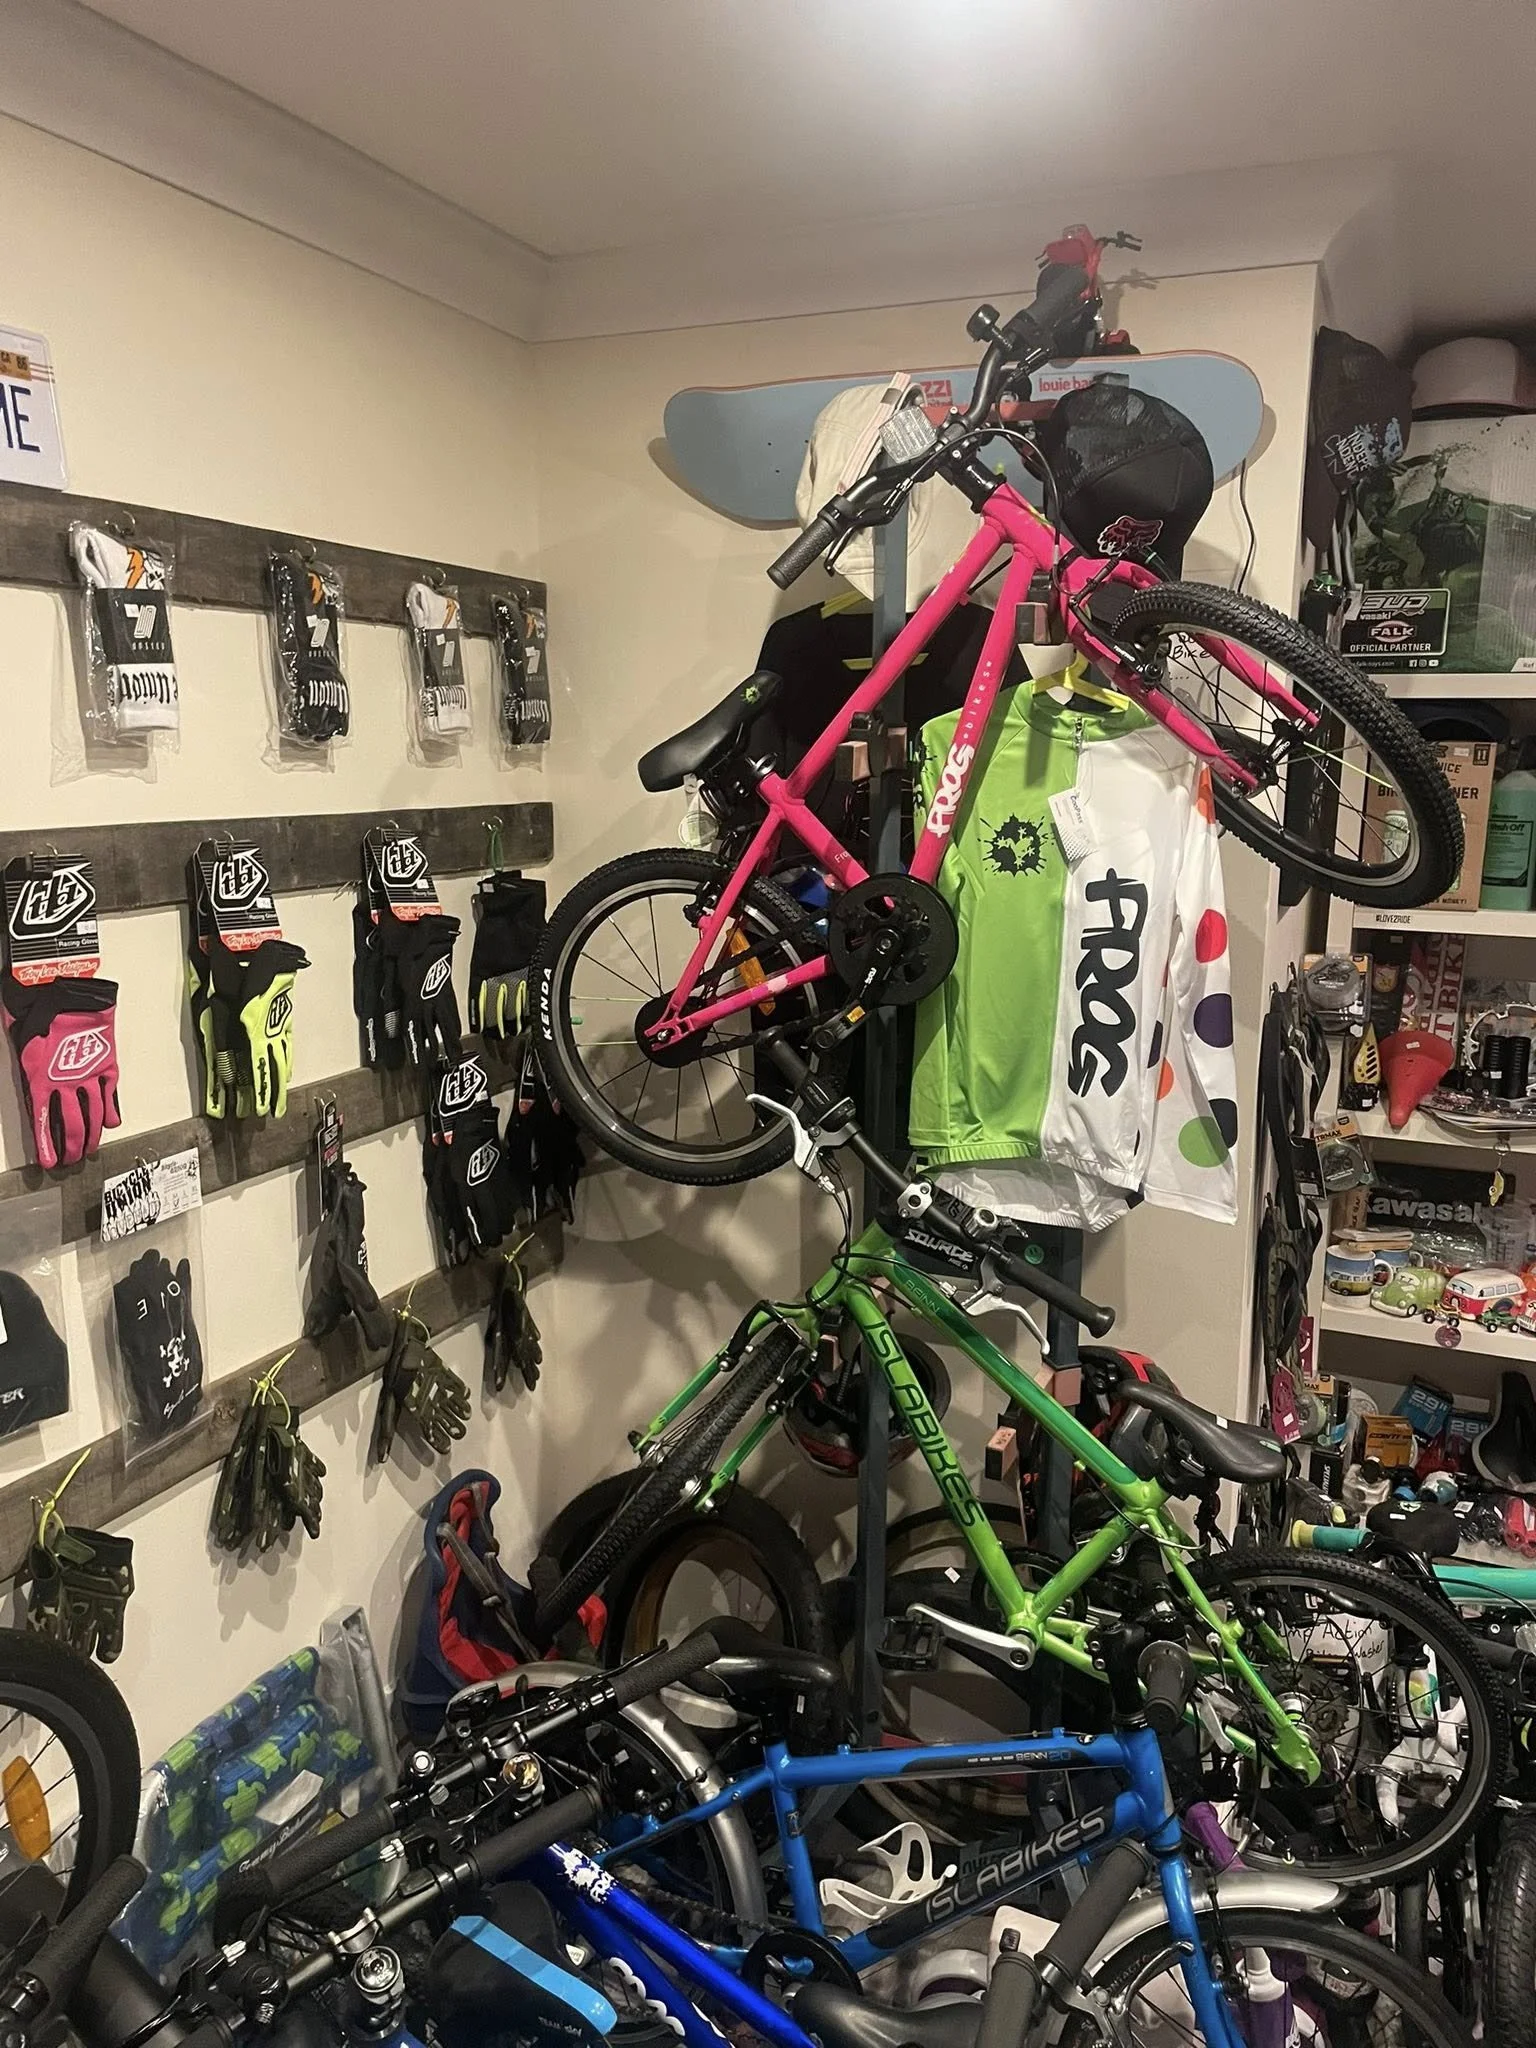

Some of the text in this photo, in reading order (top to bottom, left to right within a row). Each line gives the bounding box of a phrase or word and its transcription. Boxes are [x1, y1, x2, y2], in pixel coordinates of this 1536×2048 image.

[1039, 378, 1070, 392] louie
[1350, 642, 1432, 652] OFFICIAL PARTNER
[1370, 627, 1415, 637] FALK
[926, 742, 976, 839] FROG
[1067, 867, 1149, 1098] FROG
[540, 967, 554, 1041] KENDA
[904, 1228, 976, 1264] SOURCE
[904, 1278, 941, 1314] BEINN
[863, 1320, 985, 1528] ISLABIKES
[1322, 1619, 1373, 1640] Action
[925, 1805, 1105, 1924] ISLABIKES
